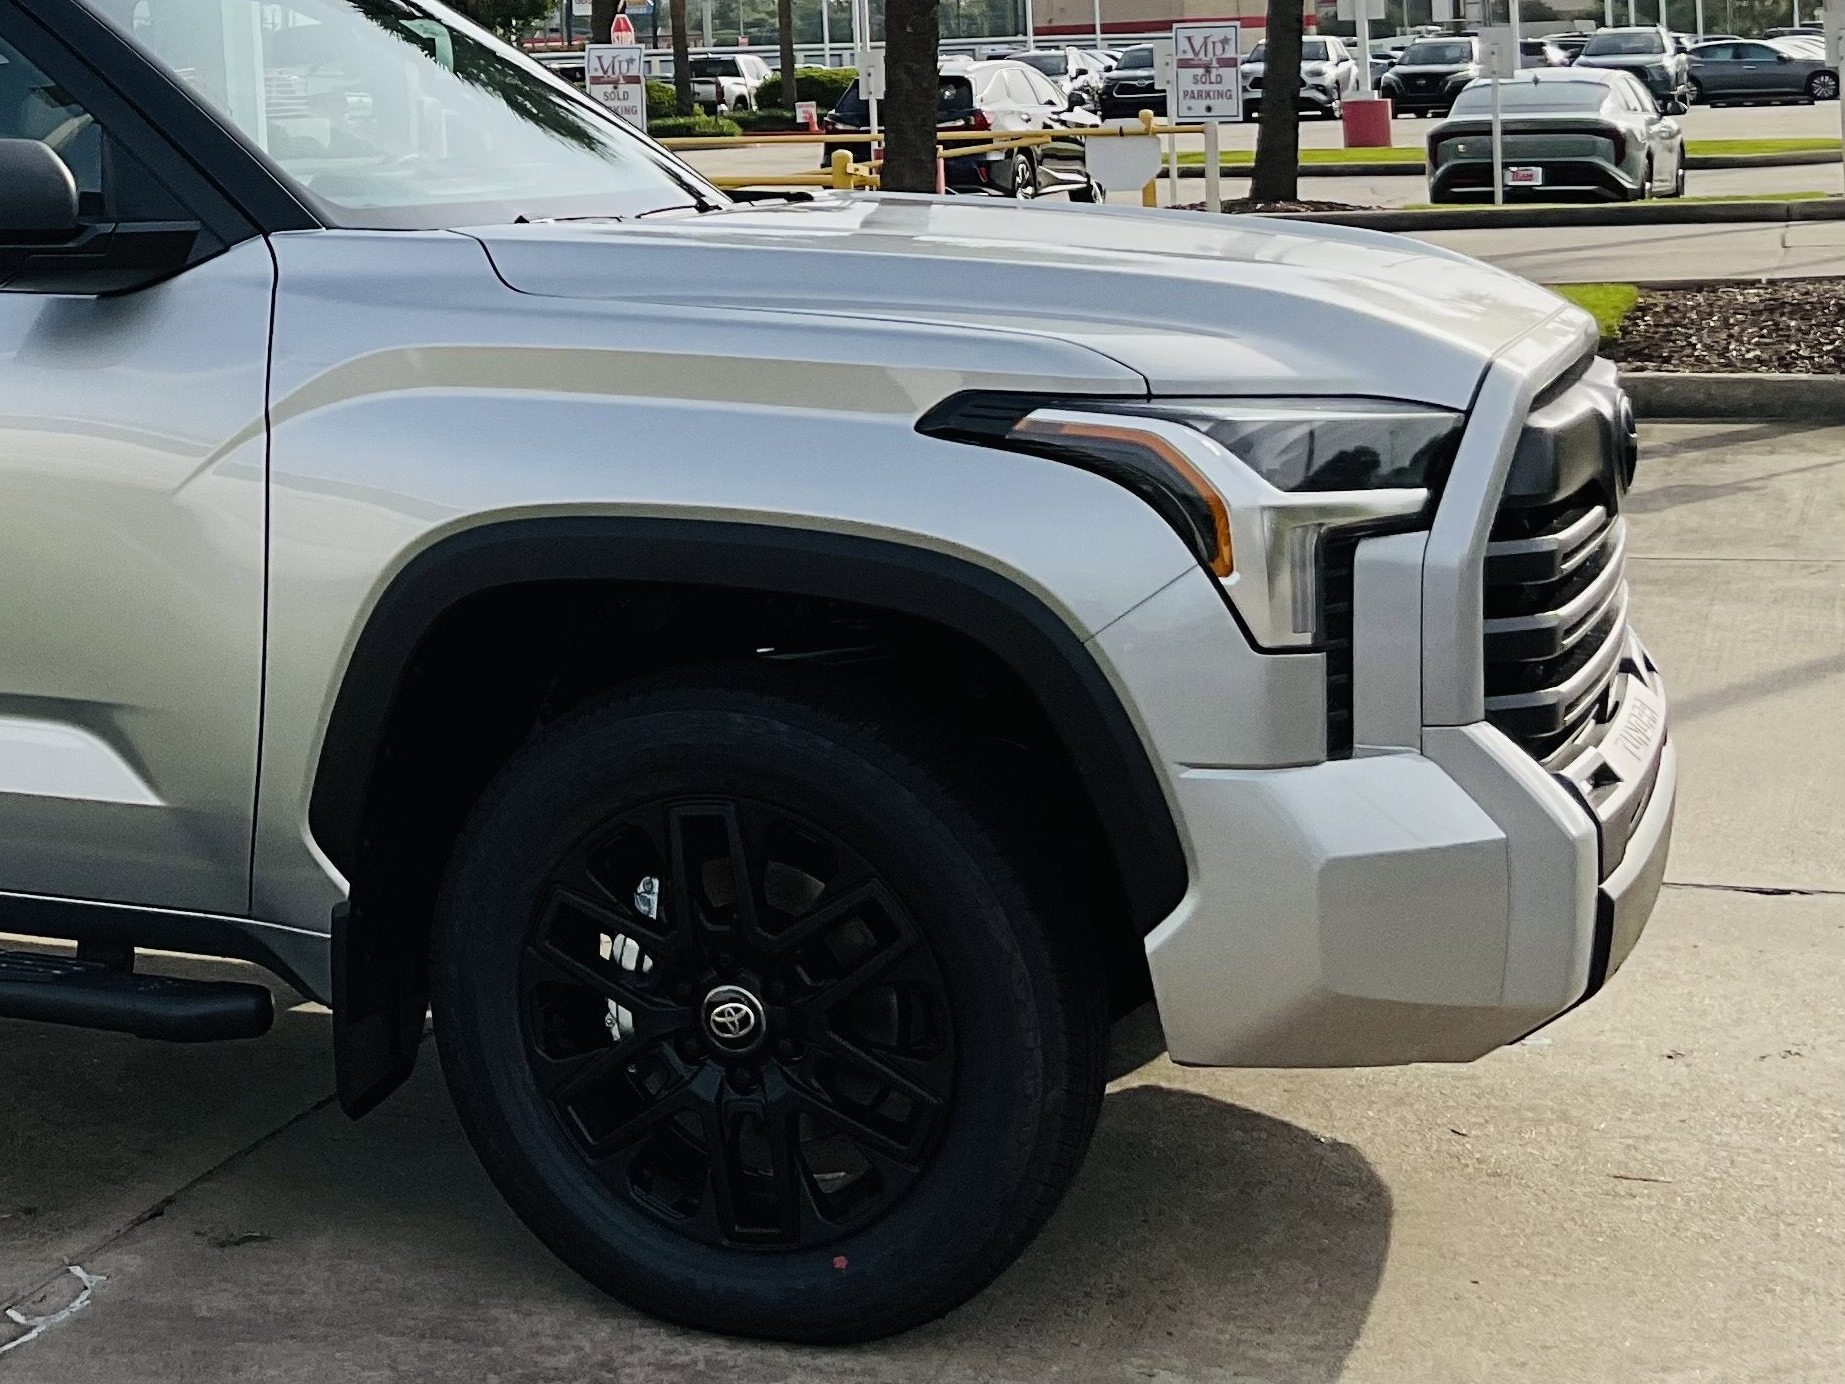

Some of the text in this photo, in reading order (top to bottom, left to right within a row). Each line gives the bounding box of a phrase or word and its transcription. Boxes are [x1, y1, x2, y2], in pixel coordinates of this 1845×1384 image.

[1192, 73, 1223, 85] SOLD
[603, 91, 629, 101] SOLD
[1183, 89, 1233, 100] PARKING
[610, 105, 638, 115] KING
